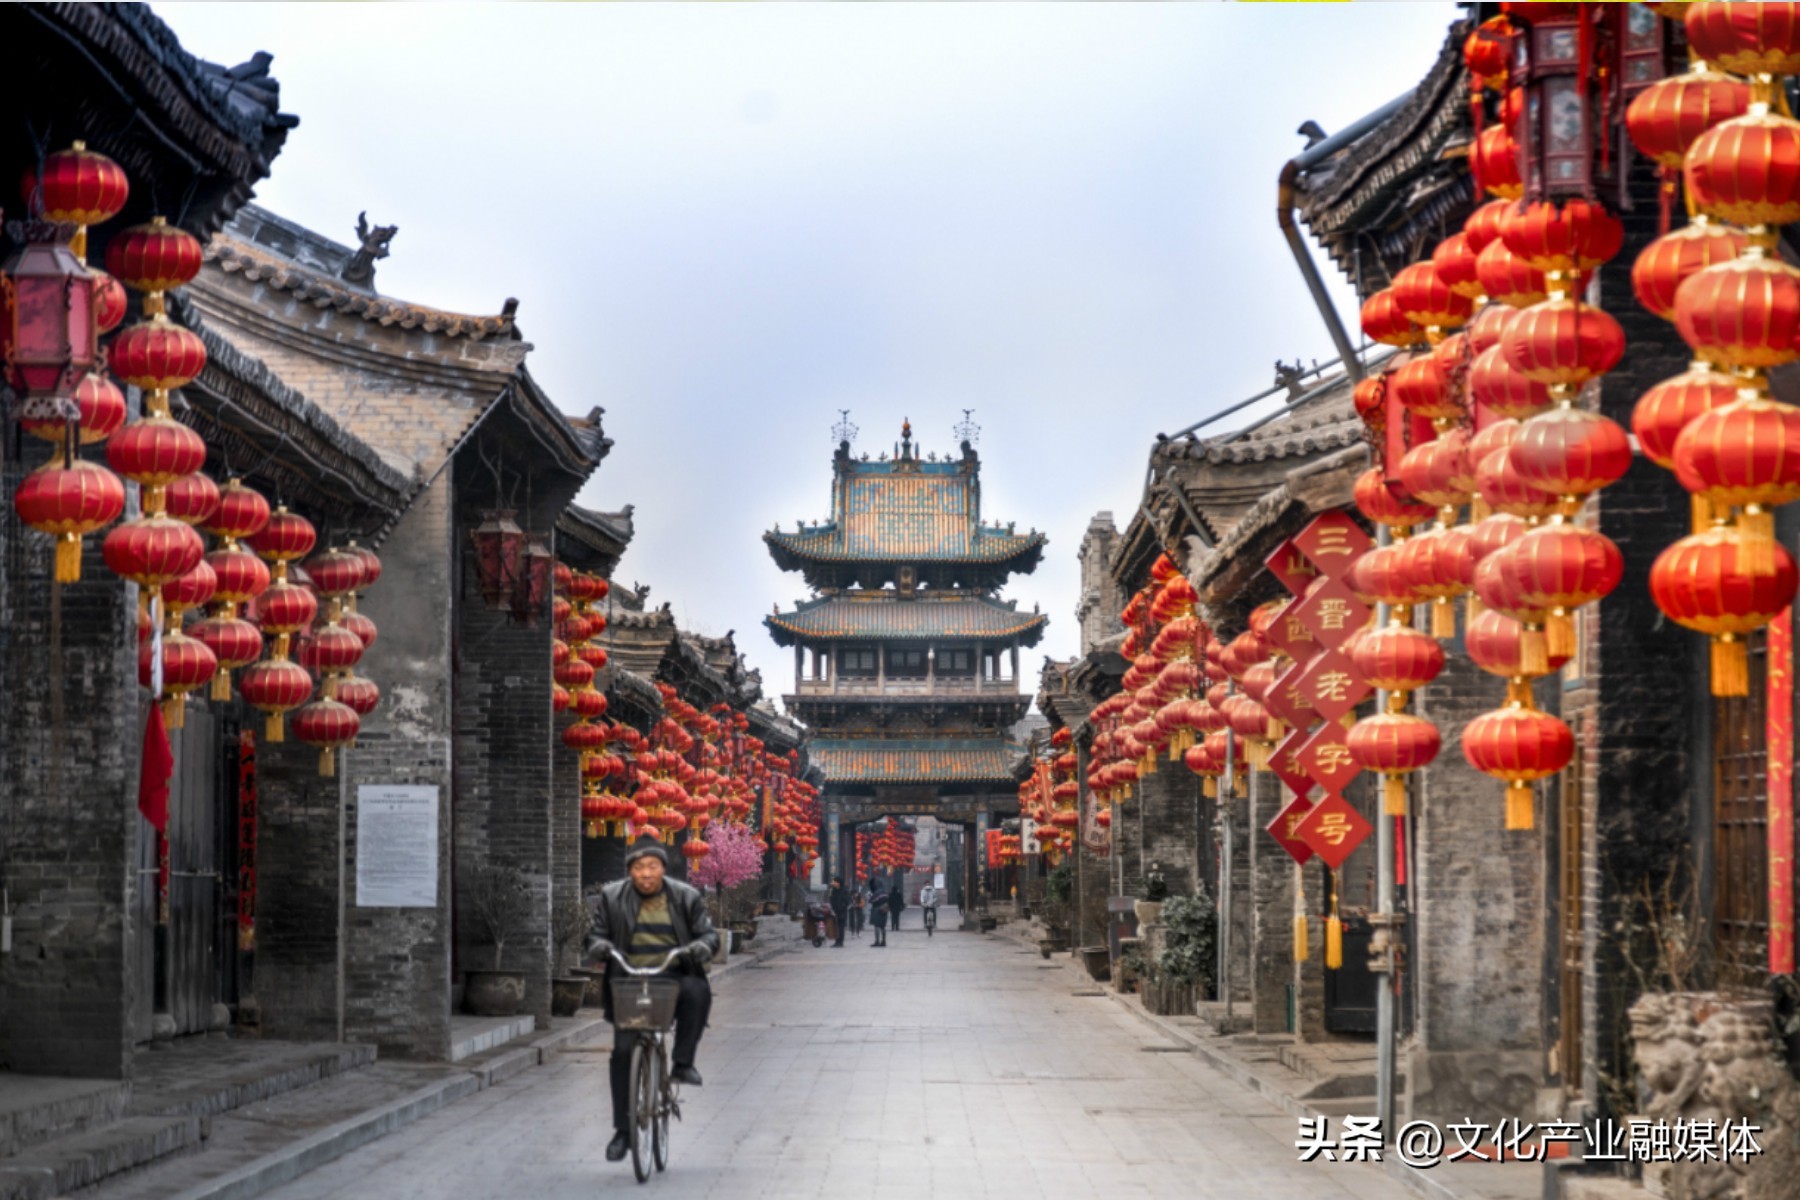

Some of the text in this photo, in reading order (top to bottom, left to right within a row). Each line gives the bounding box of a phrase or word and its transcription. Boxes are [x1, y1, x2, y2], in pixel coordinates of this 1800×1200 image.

[1315, 526, 1353, 845] 三晋老字号
